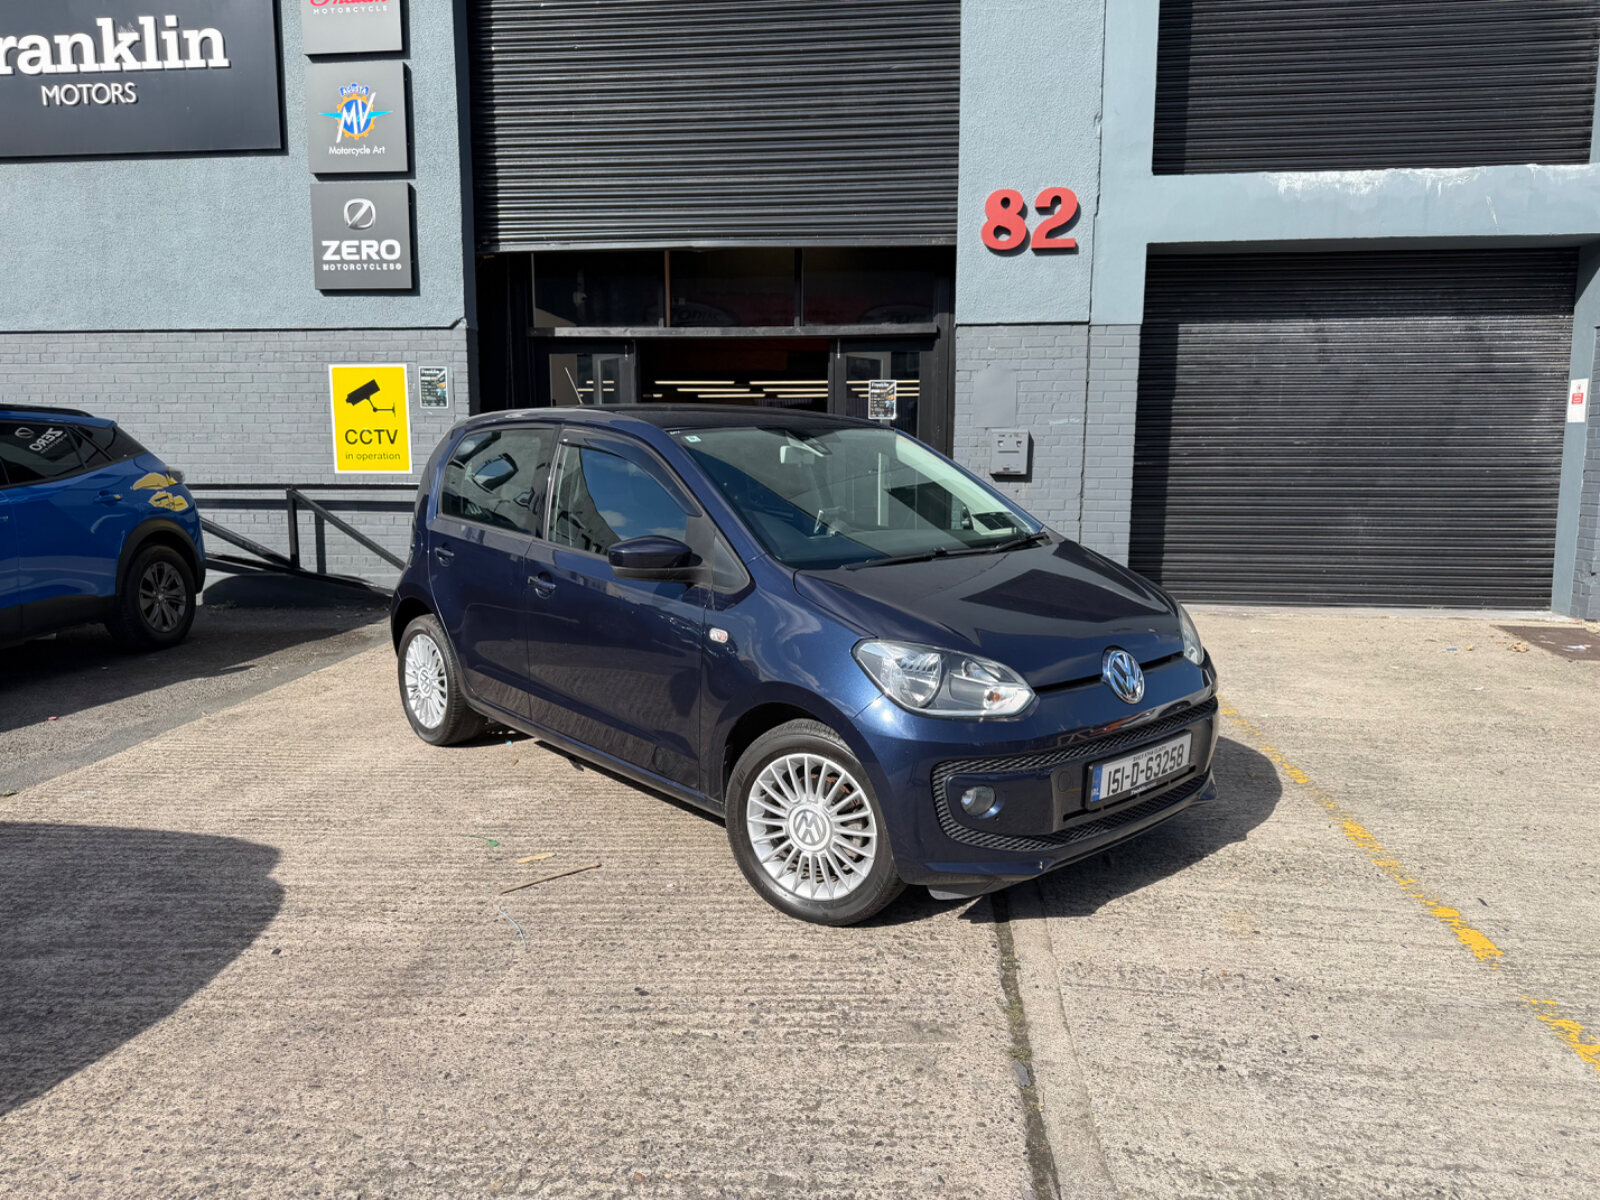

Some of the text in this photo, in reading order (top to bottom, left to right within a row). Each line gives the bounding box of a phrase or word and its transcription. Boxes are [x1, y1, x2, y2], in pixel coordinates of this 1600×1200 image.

[313, 5, 388, 15] MOTORCYCLE
[41, 82, 138, 106] MOTORS
[336, 92, 376, 143] MV
[328, 144, 386, 157] Motorcycle Art
[981, 187, 1078, 252] 82
[321, 239, 401, 261] ZERO
[345, 429, 398, 445] CCTV
[345, 452, 401, 461] in operation
[1107, 743, 1185, 796] 151-D-63258
